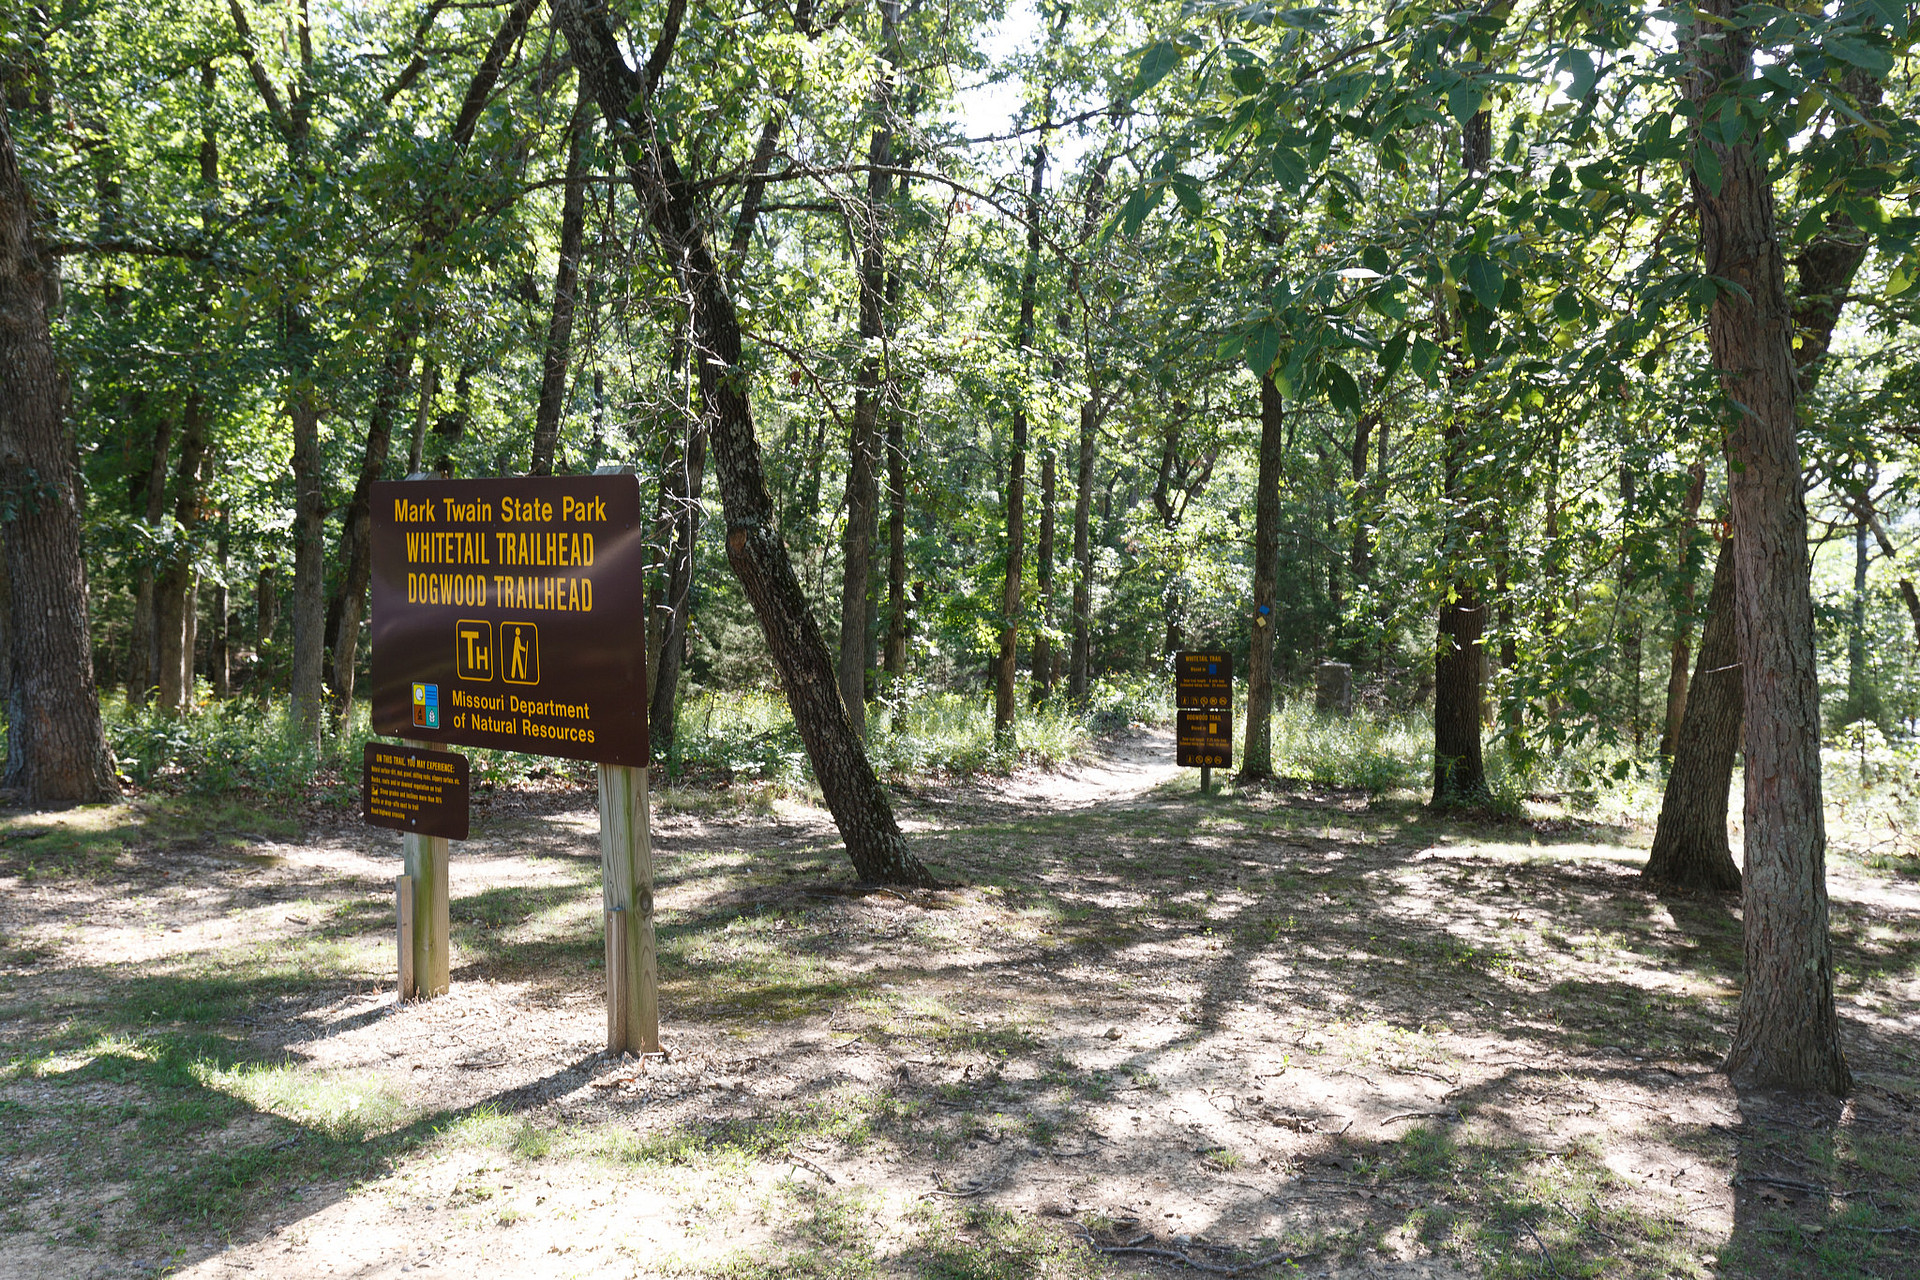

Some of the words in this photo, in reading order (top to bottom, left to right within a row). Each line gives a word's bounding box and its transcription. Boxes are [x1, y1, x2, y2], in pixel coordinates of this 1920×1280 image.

[394, 499, 435, 522] Mark
[443, 498, 492, 522] Twain
[501, 497, 552, 522] State
[562, 496, 607, 522] Park
[406, 532, 490, 564] WHITETAIL
[496, 532, 594, 566] TRAILHEAD
[408, 572, 486, 607] DOGWOOD
[494, 576, 593, 612] TRAILHEAD
[452, 690, 504, 711] Missouri
[510, 696, 590, 719] Department
[454, 712, 466, 729] of
[471, 714, 517, 735] Natural
[522, 720, 595, 743] Resources
[376, 754, 382, 763] ON
[383, 754, 392, 764] THIS
[417, 760, 425, 769] MAY
[427, 761, 455, 773] EXPERIENCE:
